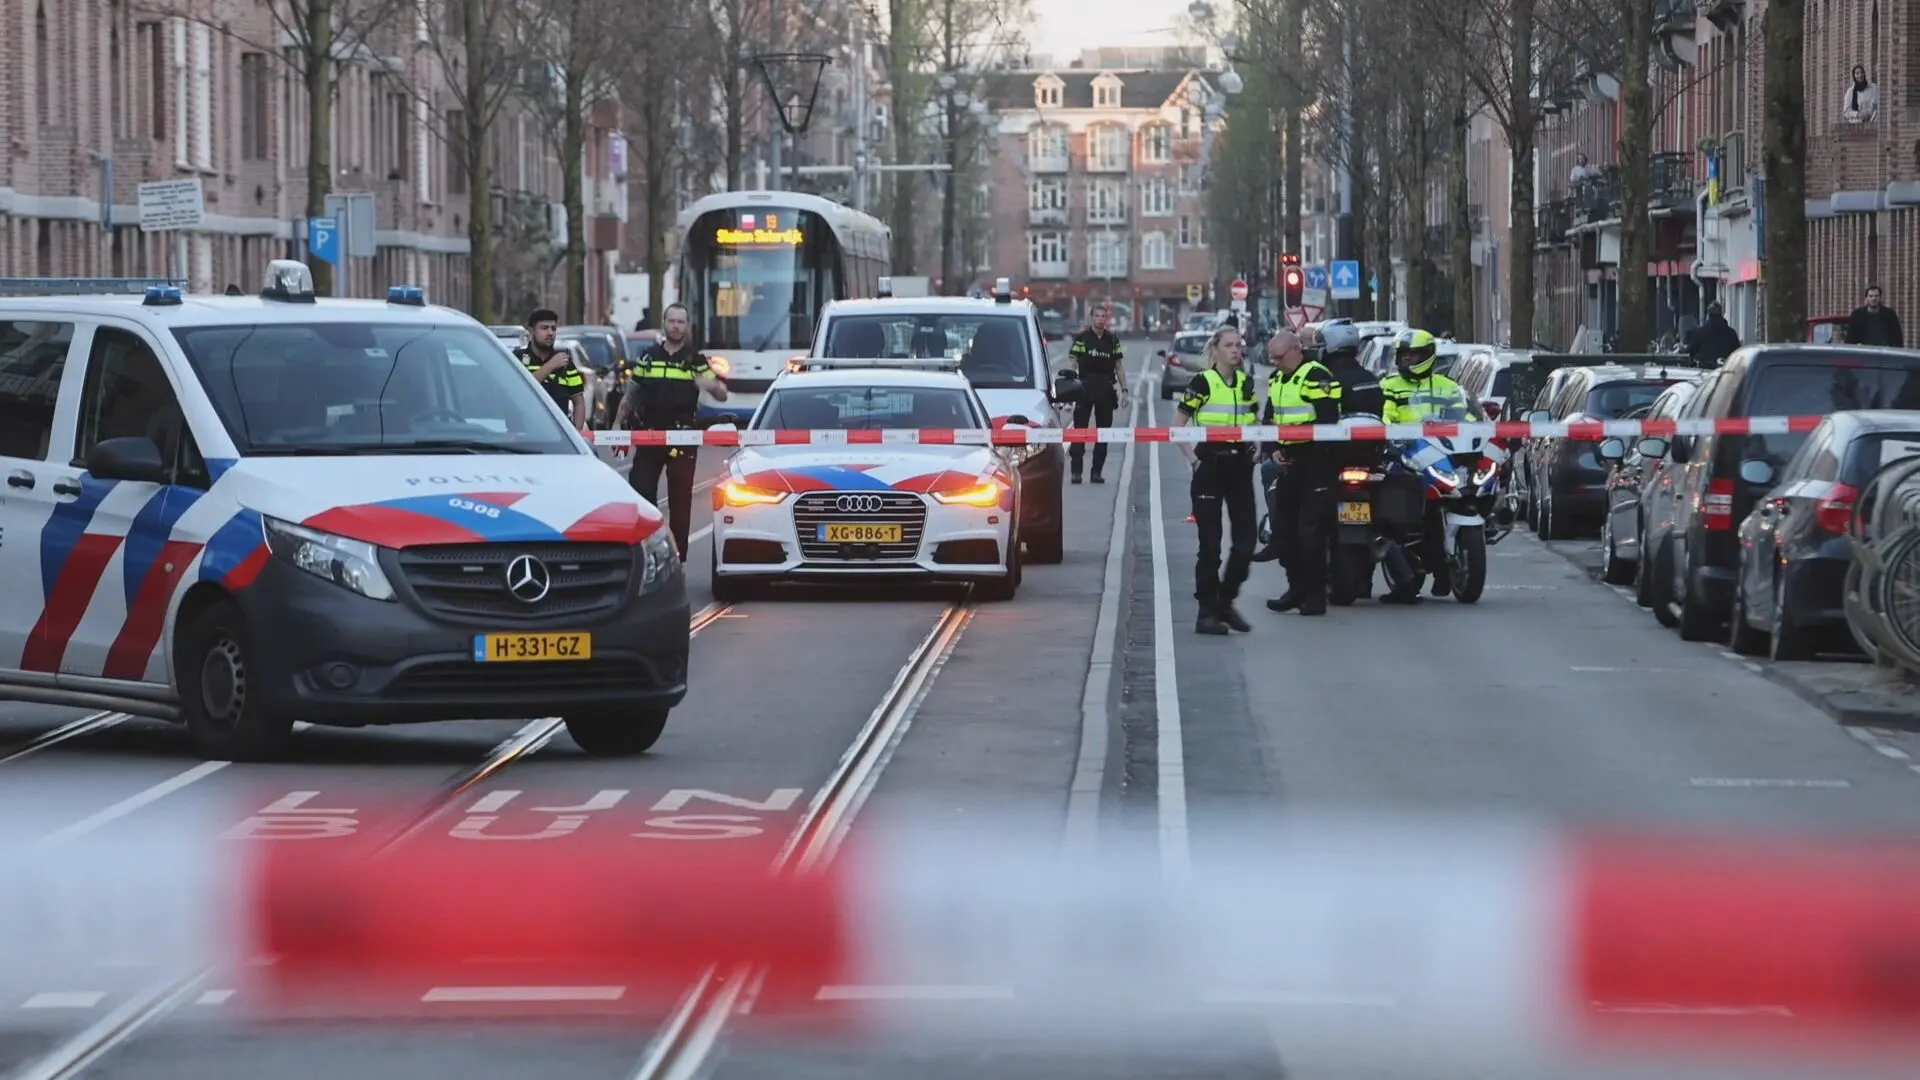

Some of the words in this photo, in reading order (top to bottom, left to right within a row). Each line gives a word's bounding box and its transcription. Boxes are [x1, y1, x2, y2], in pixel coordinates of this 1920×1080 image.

[316, 230, 329, 250] P
[405, 474, 542, 486] POLITIE
[449, 498, 501, 519] 0308
[830, 526, 897, 541] XG-886-T
[496, 636, 580, 657] H-331-GZ
[222, 815, 766, 841] BUS
